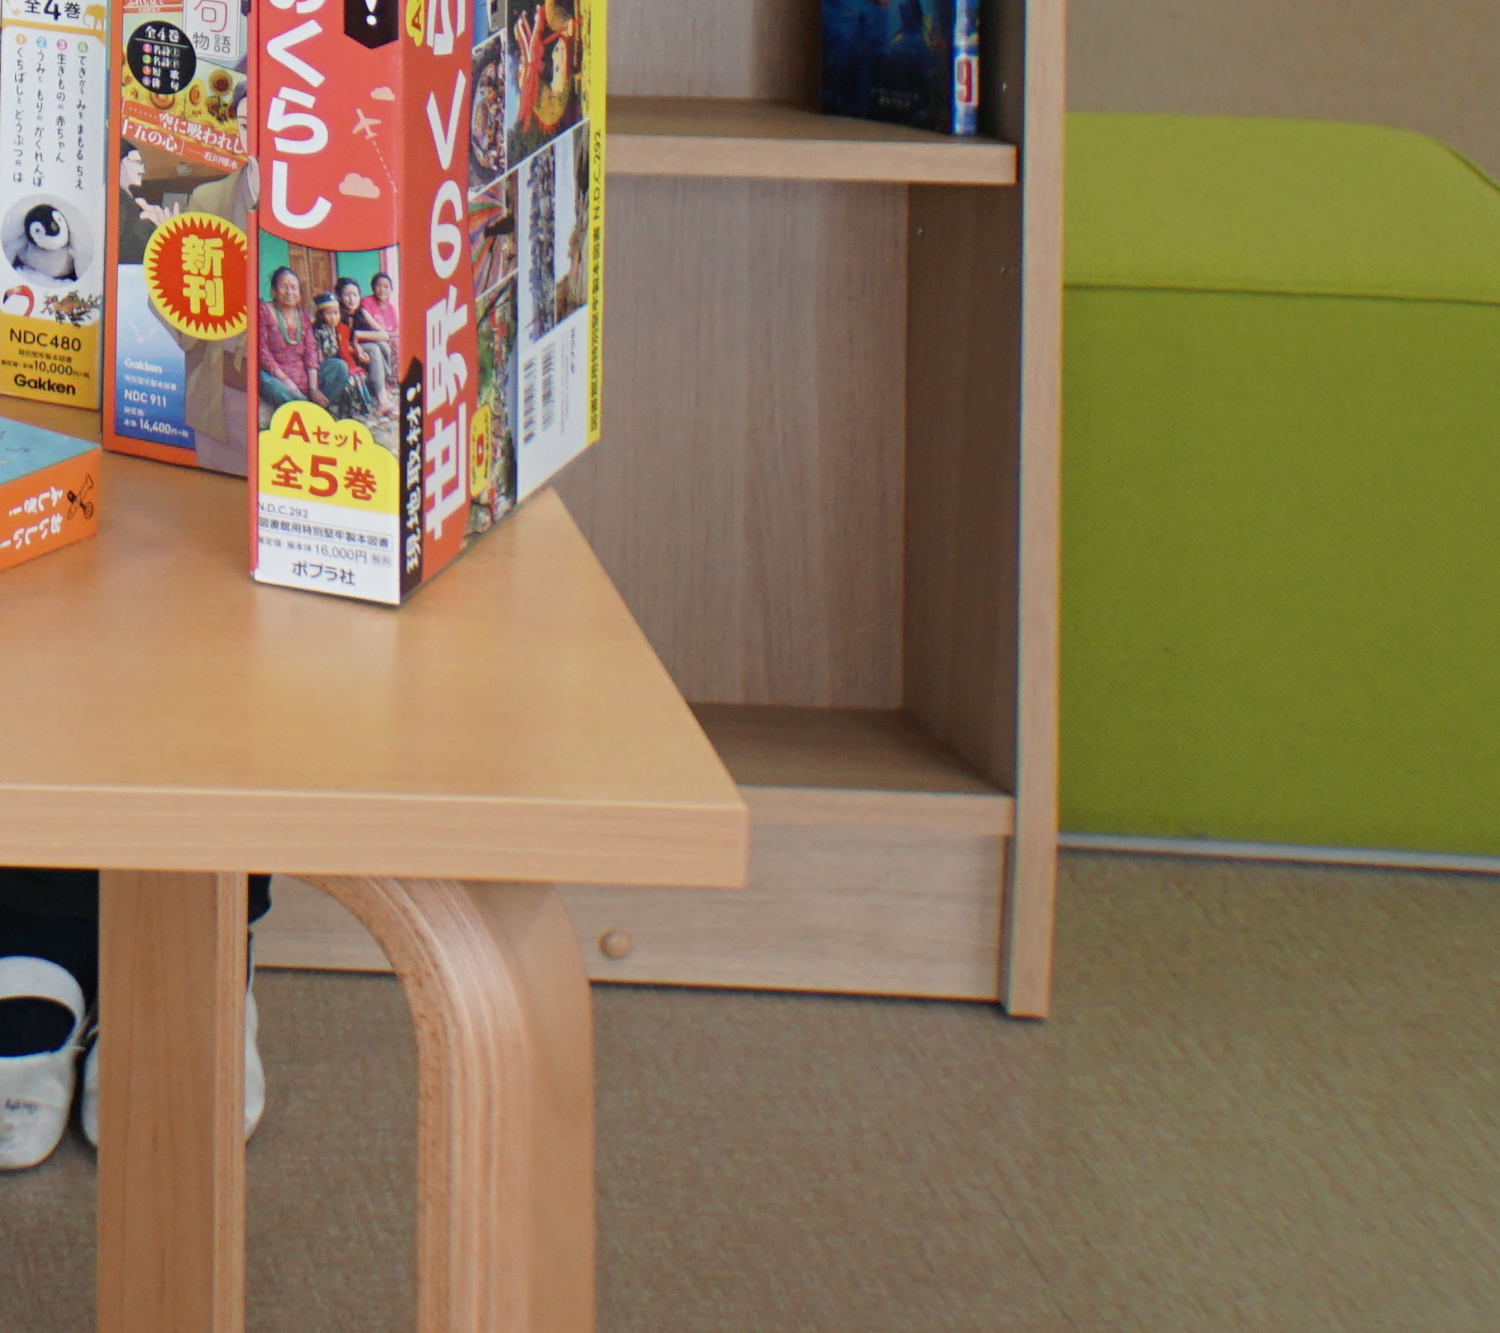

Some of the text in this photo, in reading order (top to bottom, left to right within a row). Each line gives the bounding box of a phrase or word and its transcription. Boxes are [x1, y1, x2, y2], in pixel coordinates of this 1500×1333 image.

[192, 31, 232, 54] 物語
[181, 234, 224, 318] 新刊
[9, 327, 82, 353] NDC480
[14, 373, 76, 396] Gakken
[281, 410, 364, 452] Aセット
[270, 453, 378, 502] 全5巻
[291, 560, 356, 586] ポプラ社
